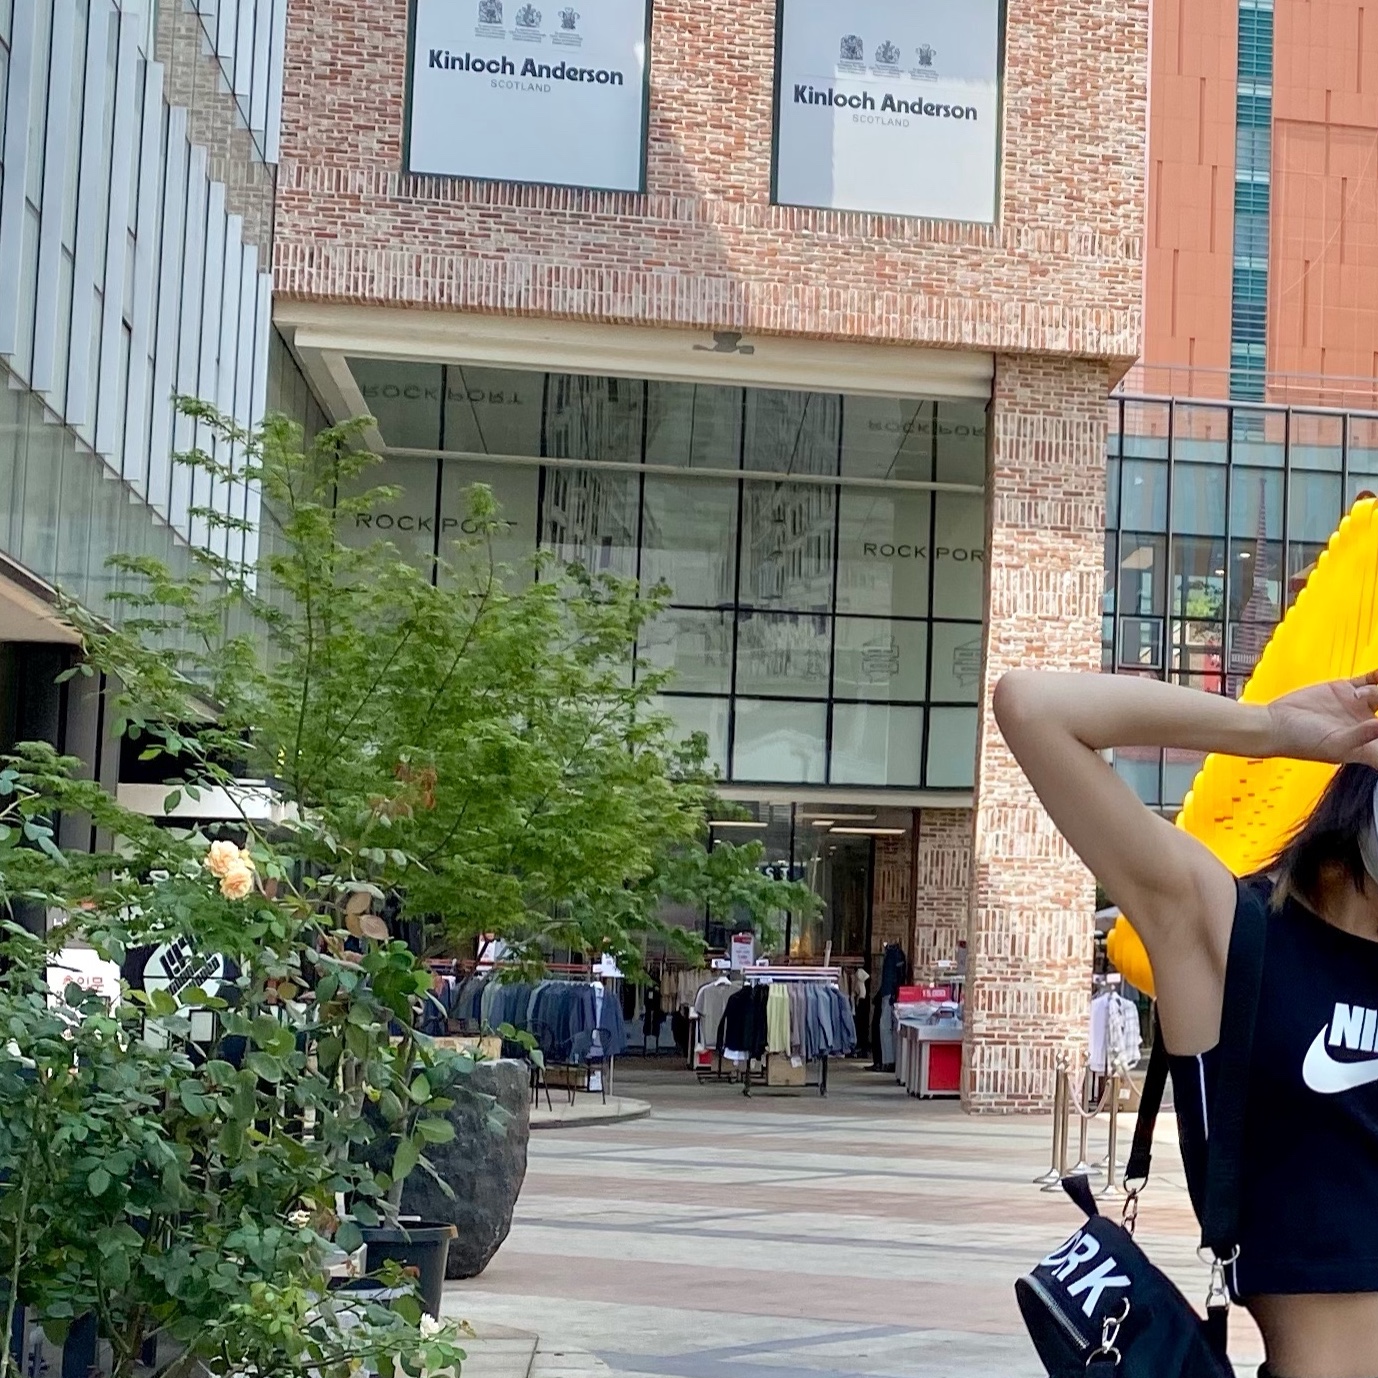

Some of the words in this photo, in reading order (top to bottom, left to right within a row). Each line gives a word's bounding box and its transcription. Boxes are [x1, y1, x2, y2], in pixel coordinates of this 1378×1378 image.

[429, 49, 515, 76] Kinloch
[520, 58, 624, 86] Anderson
[491, 79, 552, 93] SCOTLAND
[794, 84, 875, 111] Kinloch
[880, 93, 978, 120] Anderson
[852, 114, 910, 128] SCOTLAND
